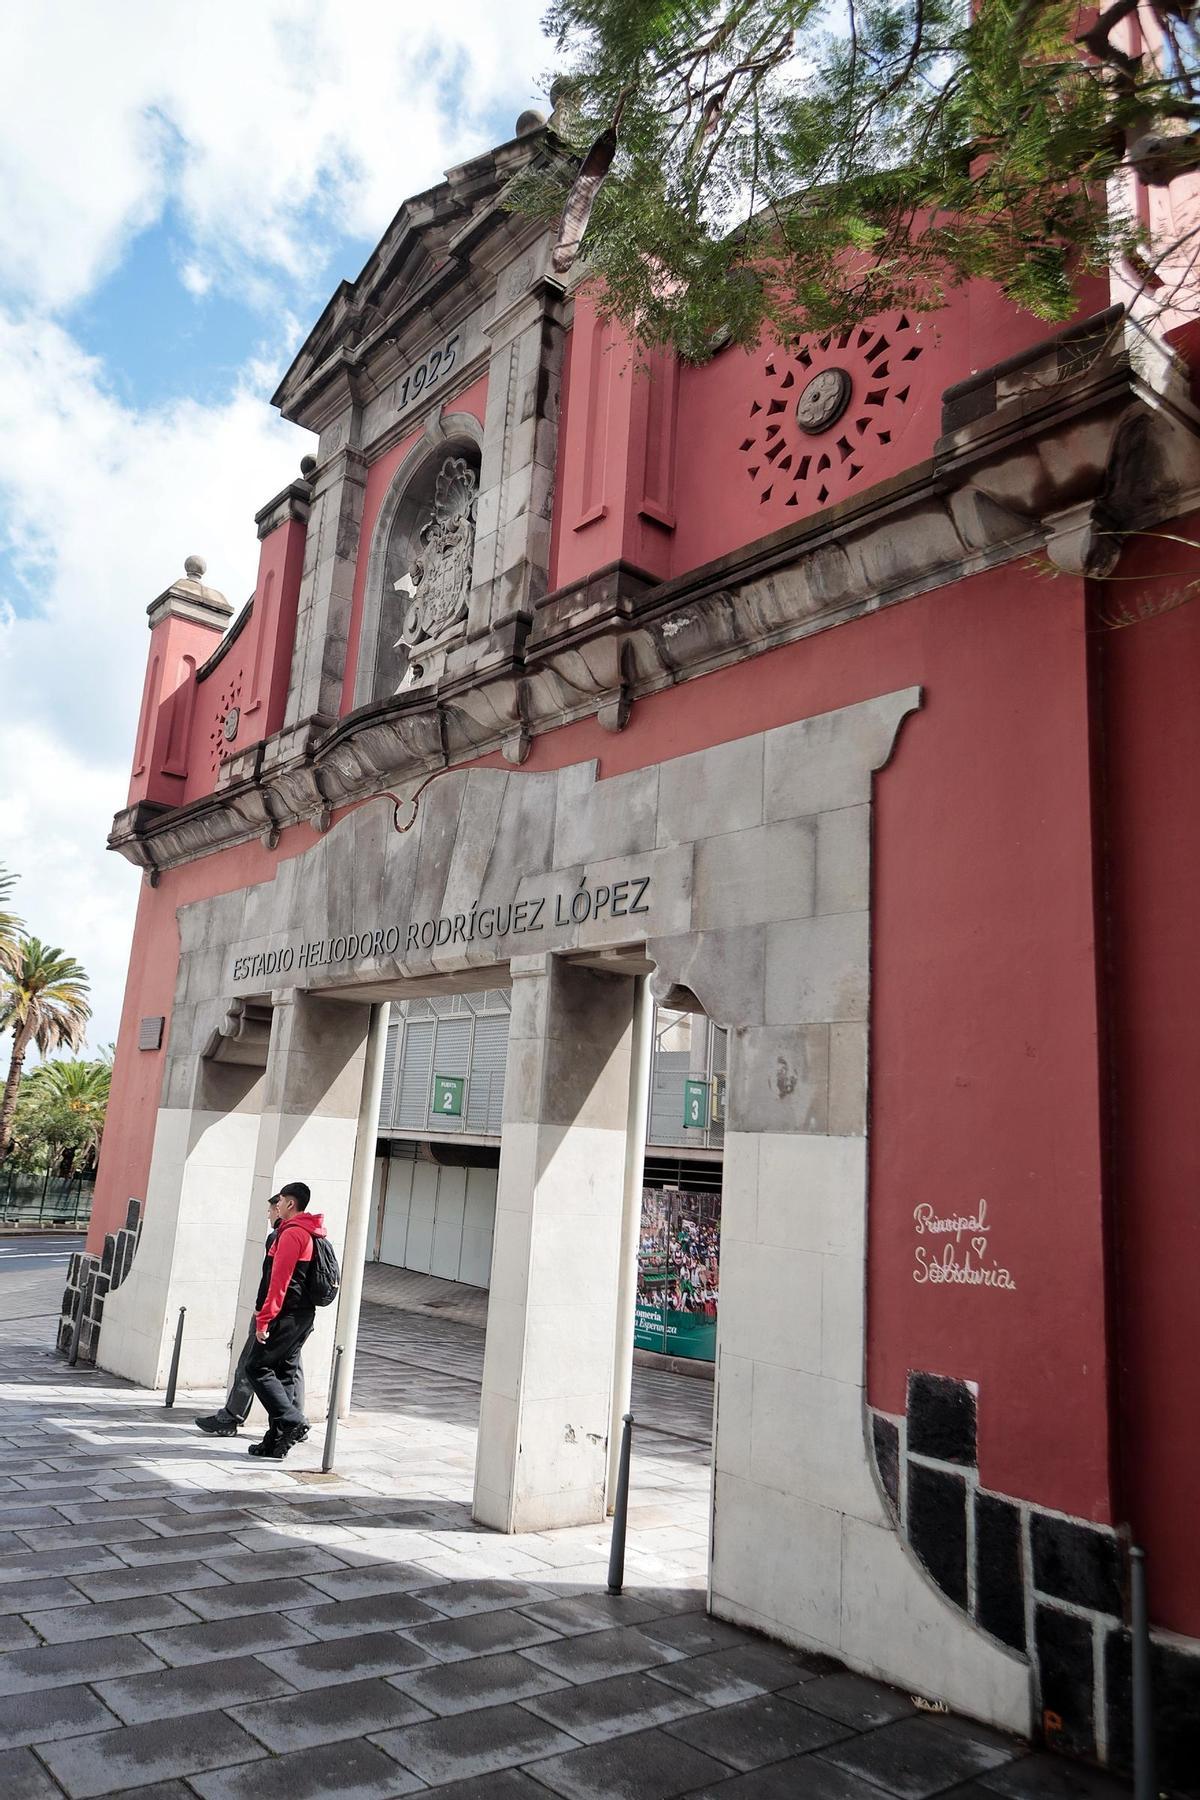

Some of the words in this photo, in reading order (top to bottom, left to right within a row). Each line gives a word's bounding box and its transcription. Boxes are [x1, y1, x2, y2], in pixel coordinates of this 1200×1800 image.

[397, 334, 460, 412] 1925
[233, 947, 295, 981] ESTADIO
[298, 925, 400, 968] HELIODORO
[406, 897, 546, 951] RODRÍGUEZ
[554, 876, 650, 927] LÓPEZ
[443, 1091, 453, 1109] 2
[692, 1099, 699, 1120] 3
